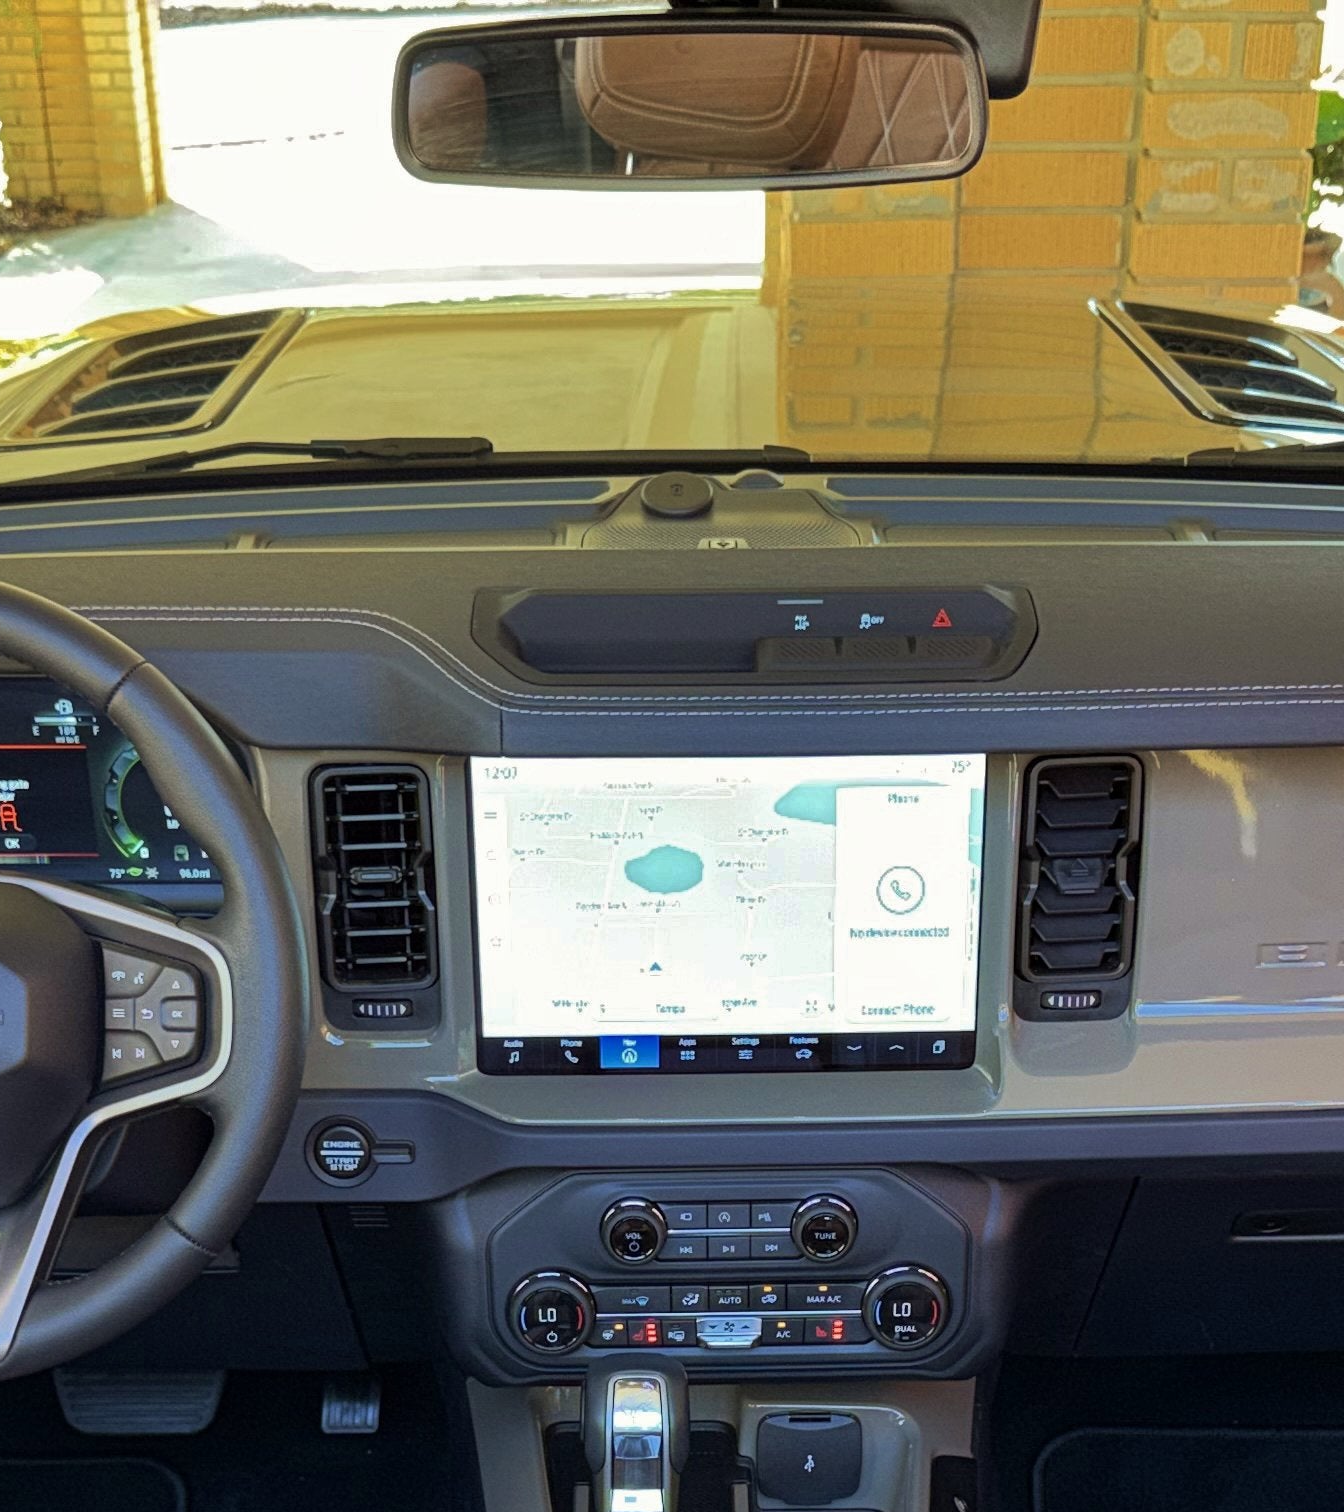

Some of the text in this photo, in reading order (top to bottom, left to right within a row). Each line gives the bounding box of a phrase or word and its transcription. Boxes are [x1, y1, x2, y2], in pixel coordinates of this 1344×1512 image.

[31, 725, 40, 736] E
[4, 838, 21, 849] OK
[171, 1010, 183, 1018] OK
[560, 1038, 583, 1048] Phone
[678, 1037, 697, 1047] Apps
[731, 1036, 760, 1046] Settings
[323, 1141, 361, 1149] ENGINE
[625, 1232, 643, 1240] VOL
[814, 1232, 837, 1240] TUNE
[718, 1296, 742, 1305] AUTO
[806, 1295, 842, 1304] MAX A/C
[892, 1302, 912, 1318] LO
[538, 1307, 557, 1323] LO
[894, 1325, 917, 1334] DUAL
[775, 1330, 791, 1339] A/C
